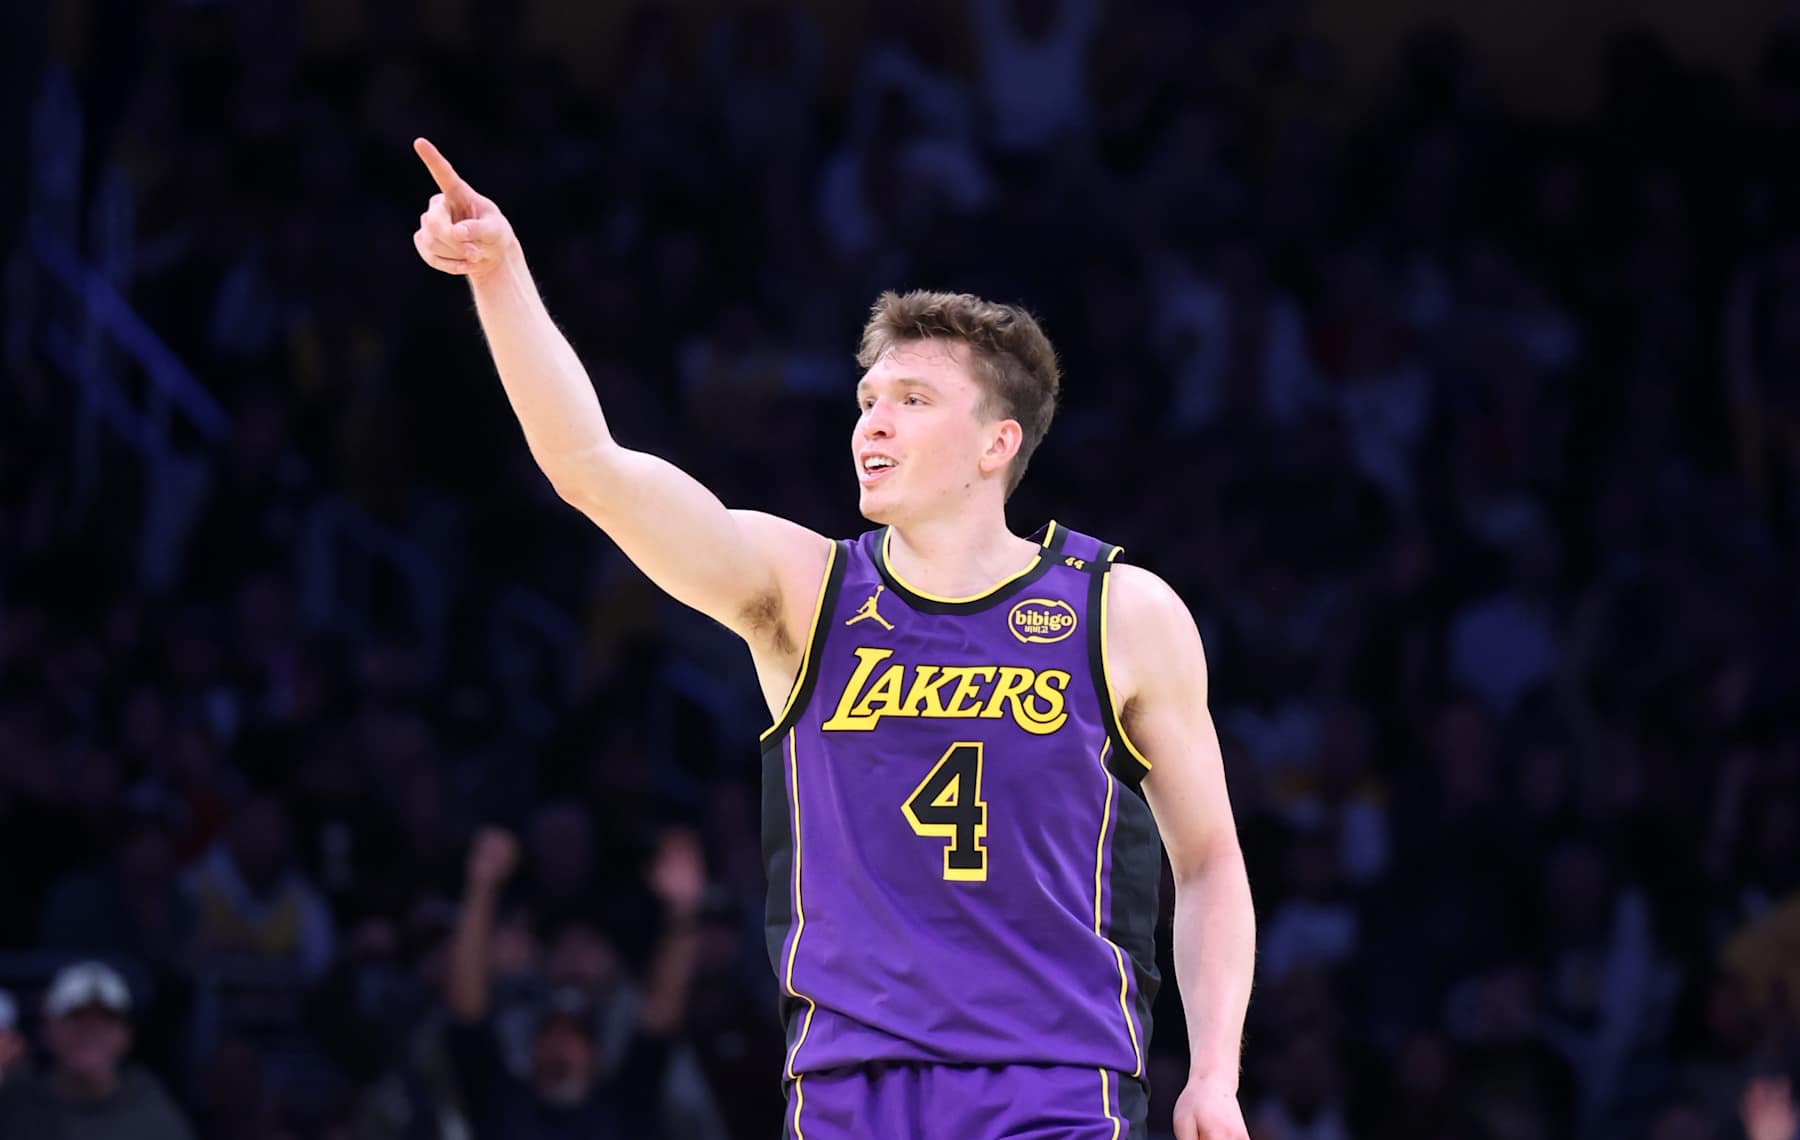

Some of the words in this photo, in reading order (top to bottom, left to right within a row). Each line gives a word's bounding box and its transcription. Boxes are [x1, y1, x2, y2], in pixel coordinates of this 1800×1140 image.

[1015, 609, 1073, 631] bibigo
[822, 647, 1071, 735] LAKERS
[901, 741, 987, 881] 4
